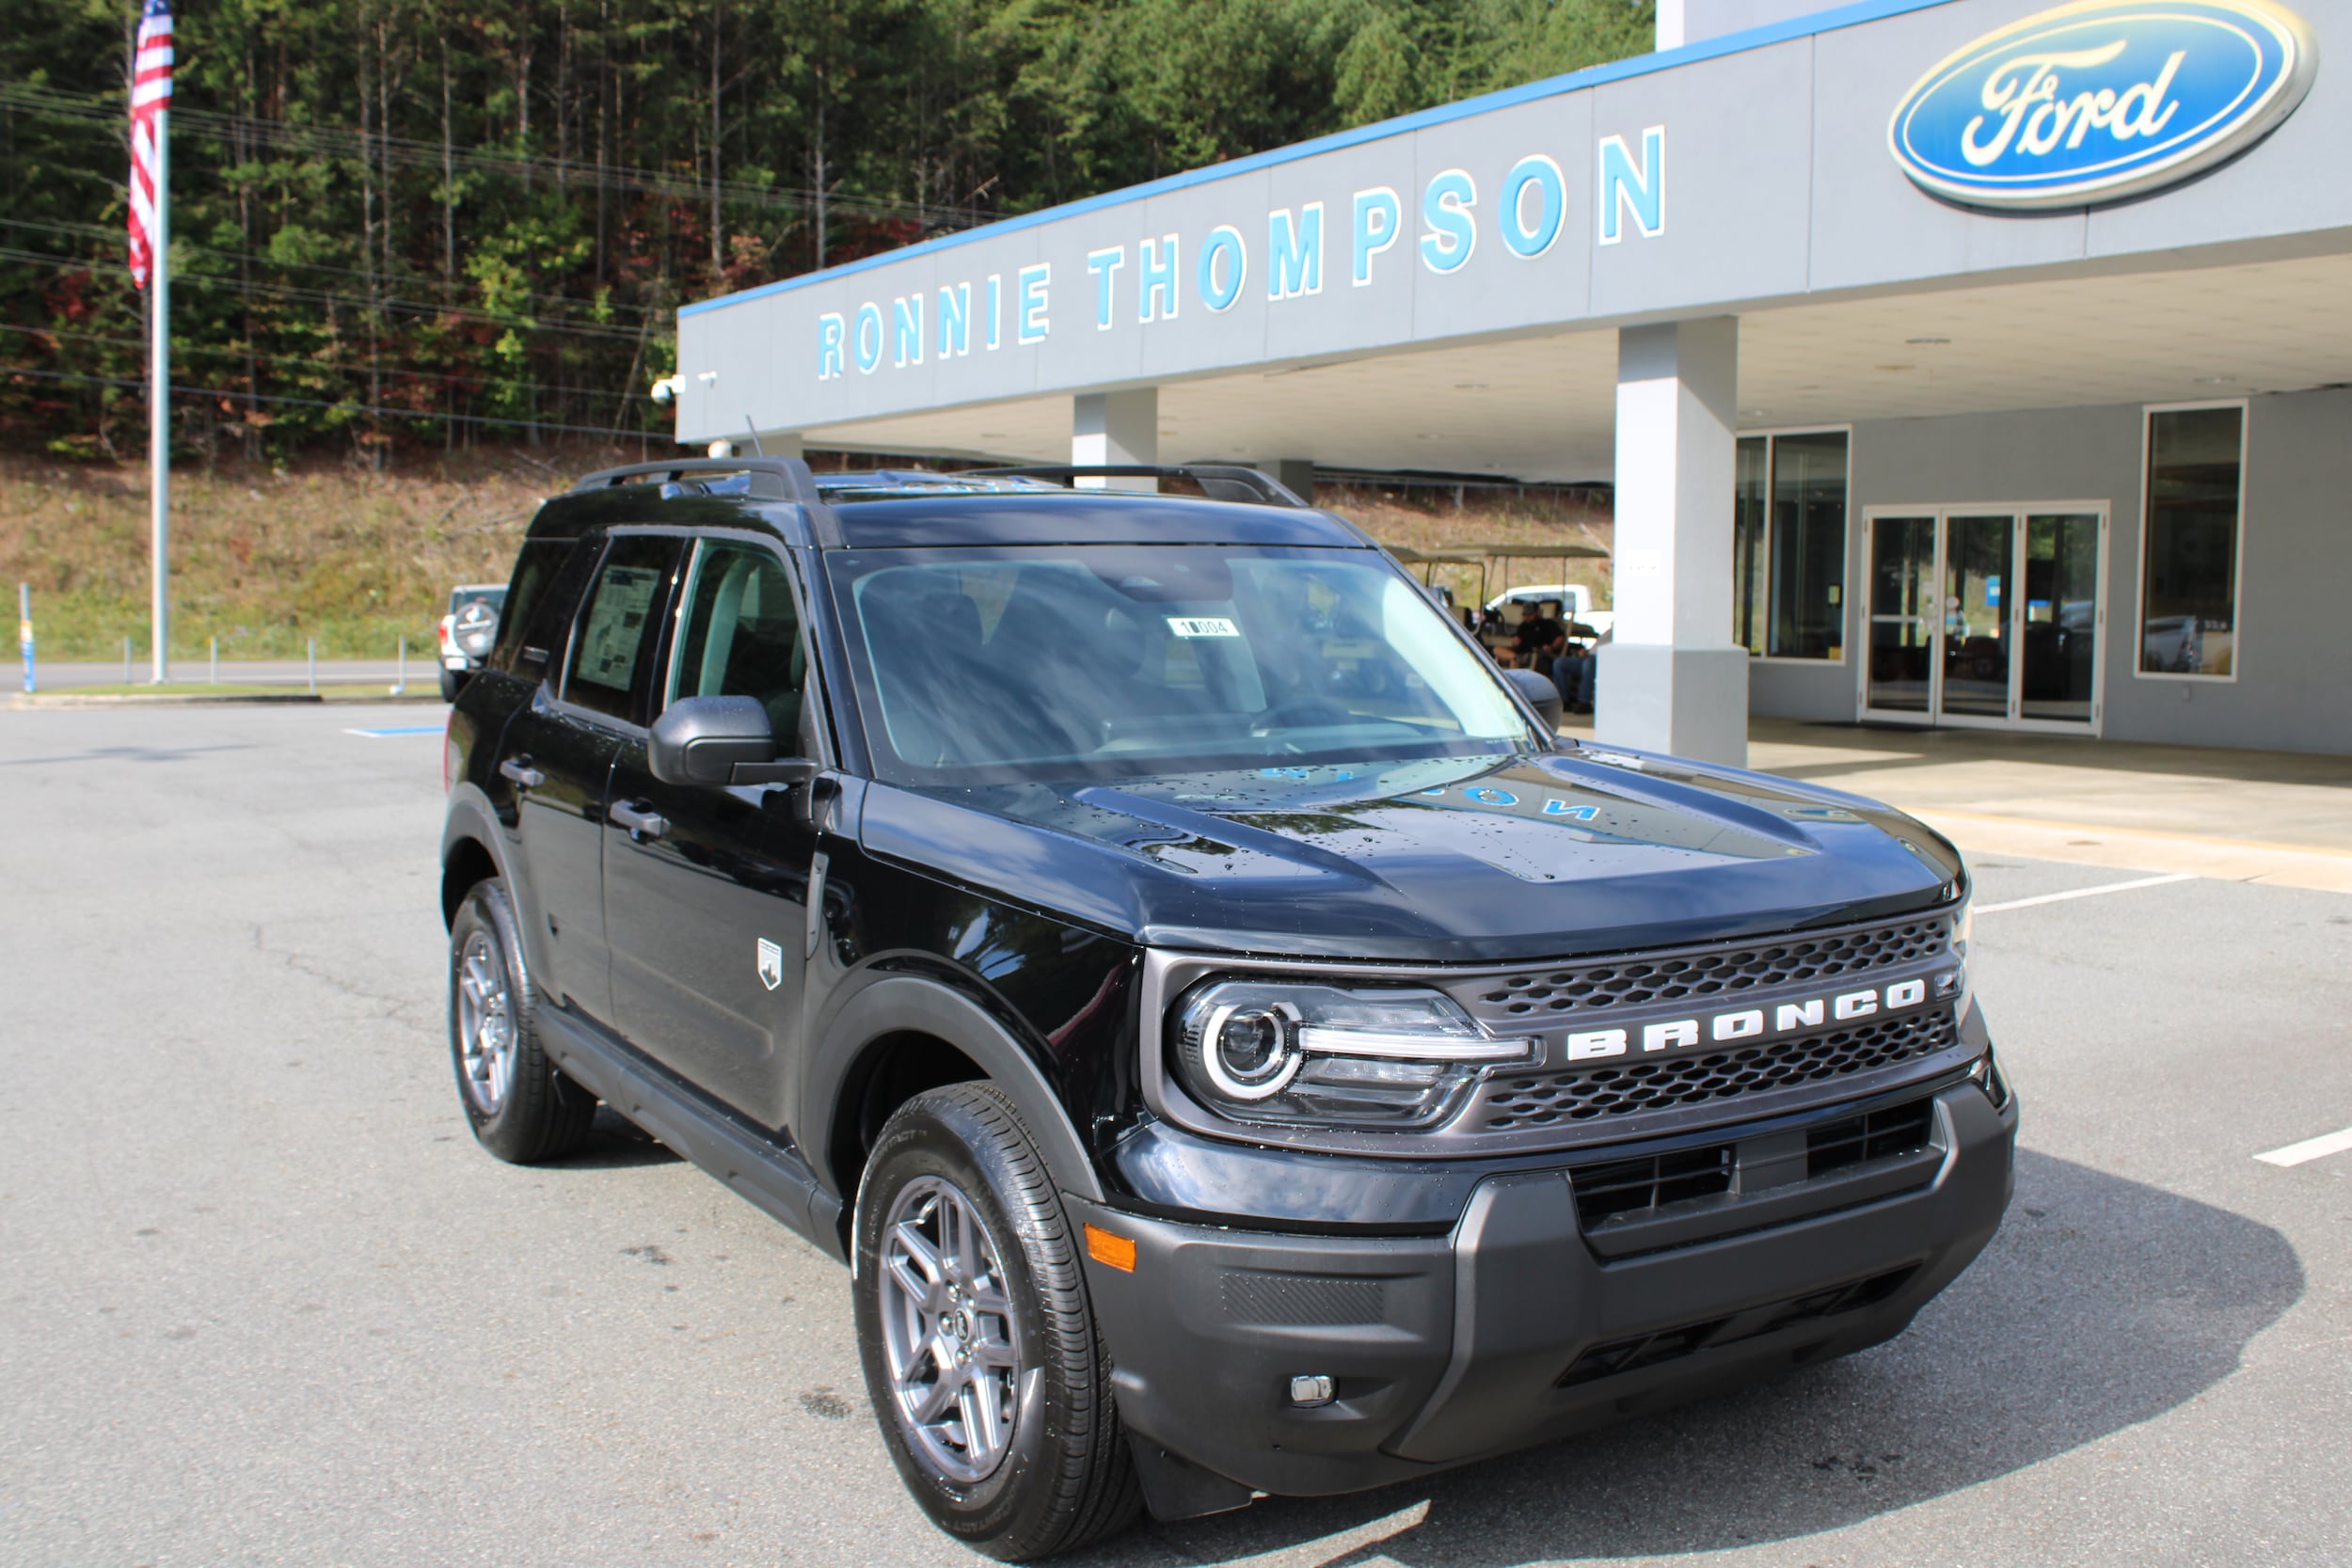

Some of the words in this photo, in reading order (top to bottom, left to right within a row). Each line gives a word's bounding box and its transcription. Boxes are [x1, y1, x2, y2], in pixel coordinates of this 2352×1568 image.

[1961, 40, 2186, 166] Ford
[818, 261, 1051, 381] RONNIE
[1087, 124, 1666, 331] THOMPSON
[1567, 978, 1926, 1061] BRONCO
